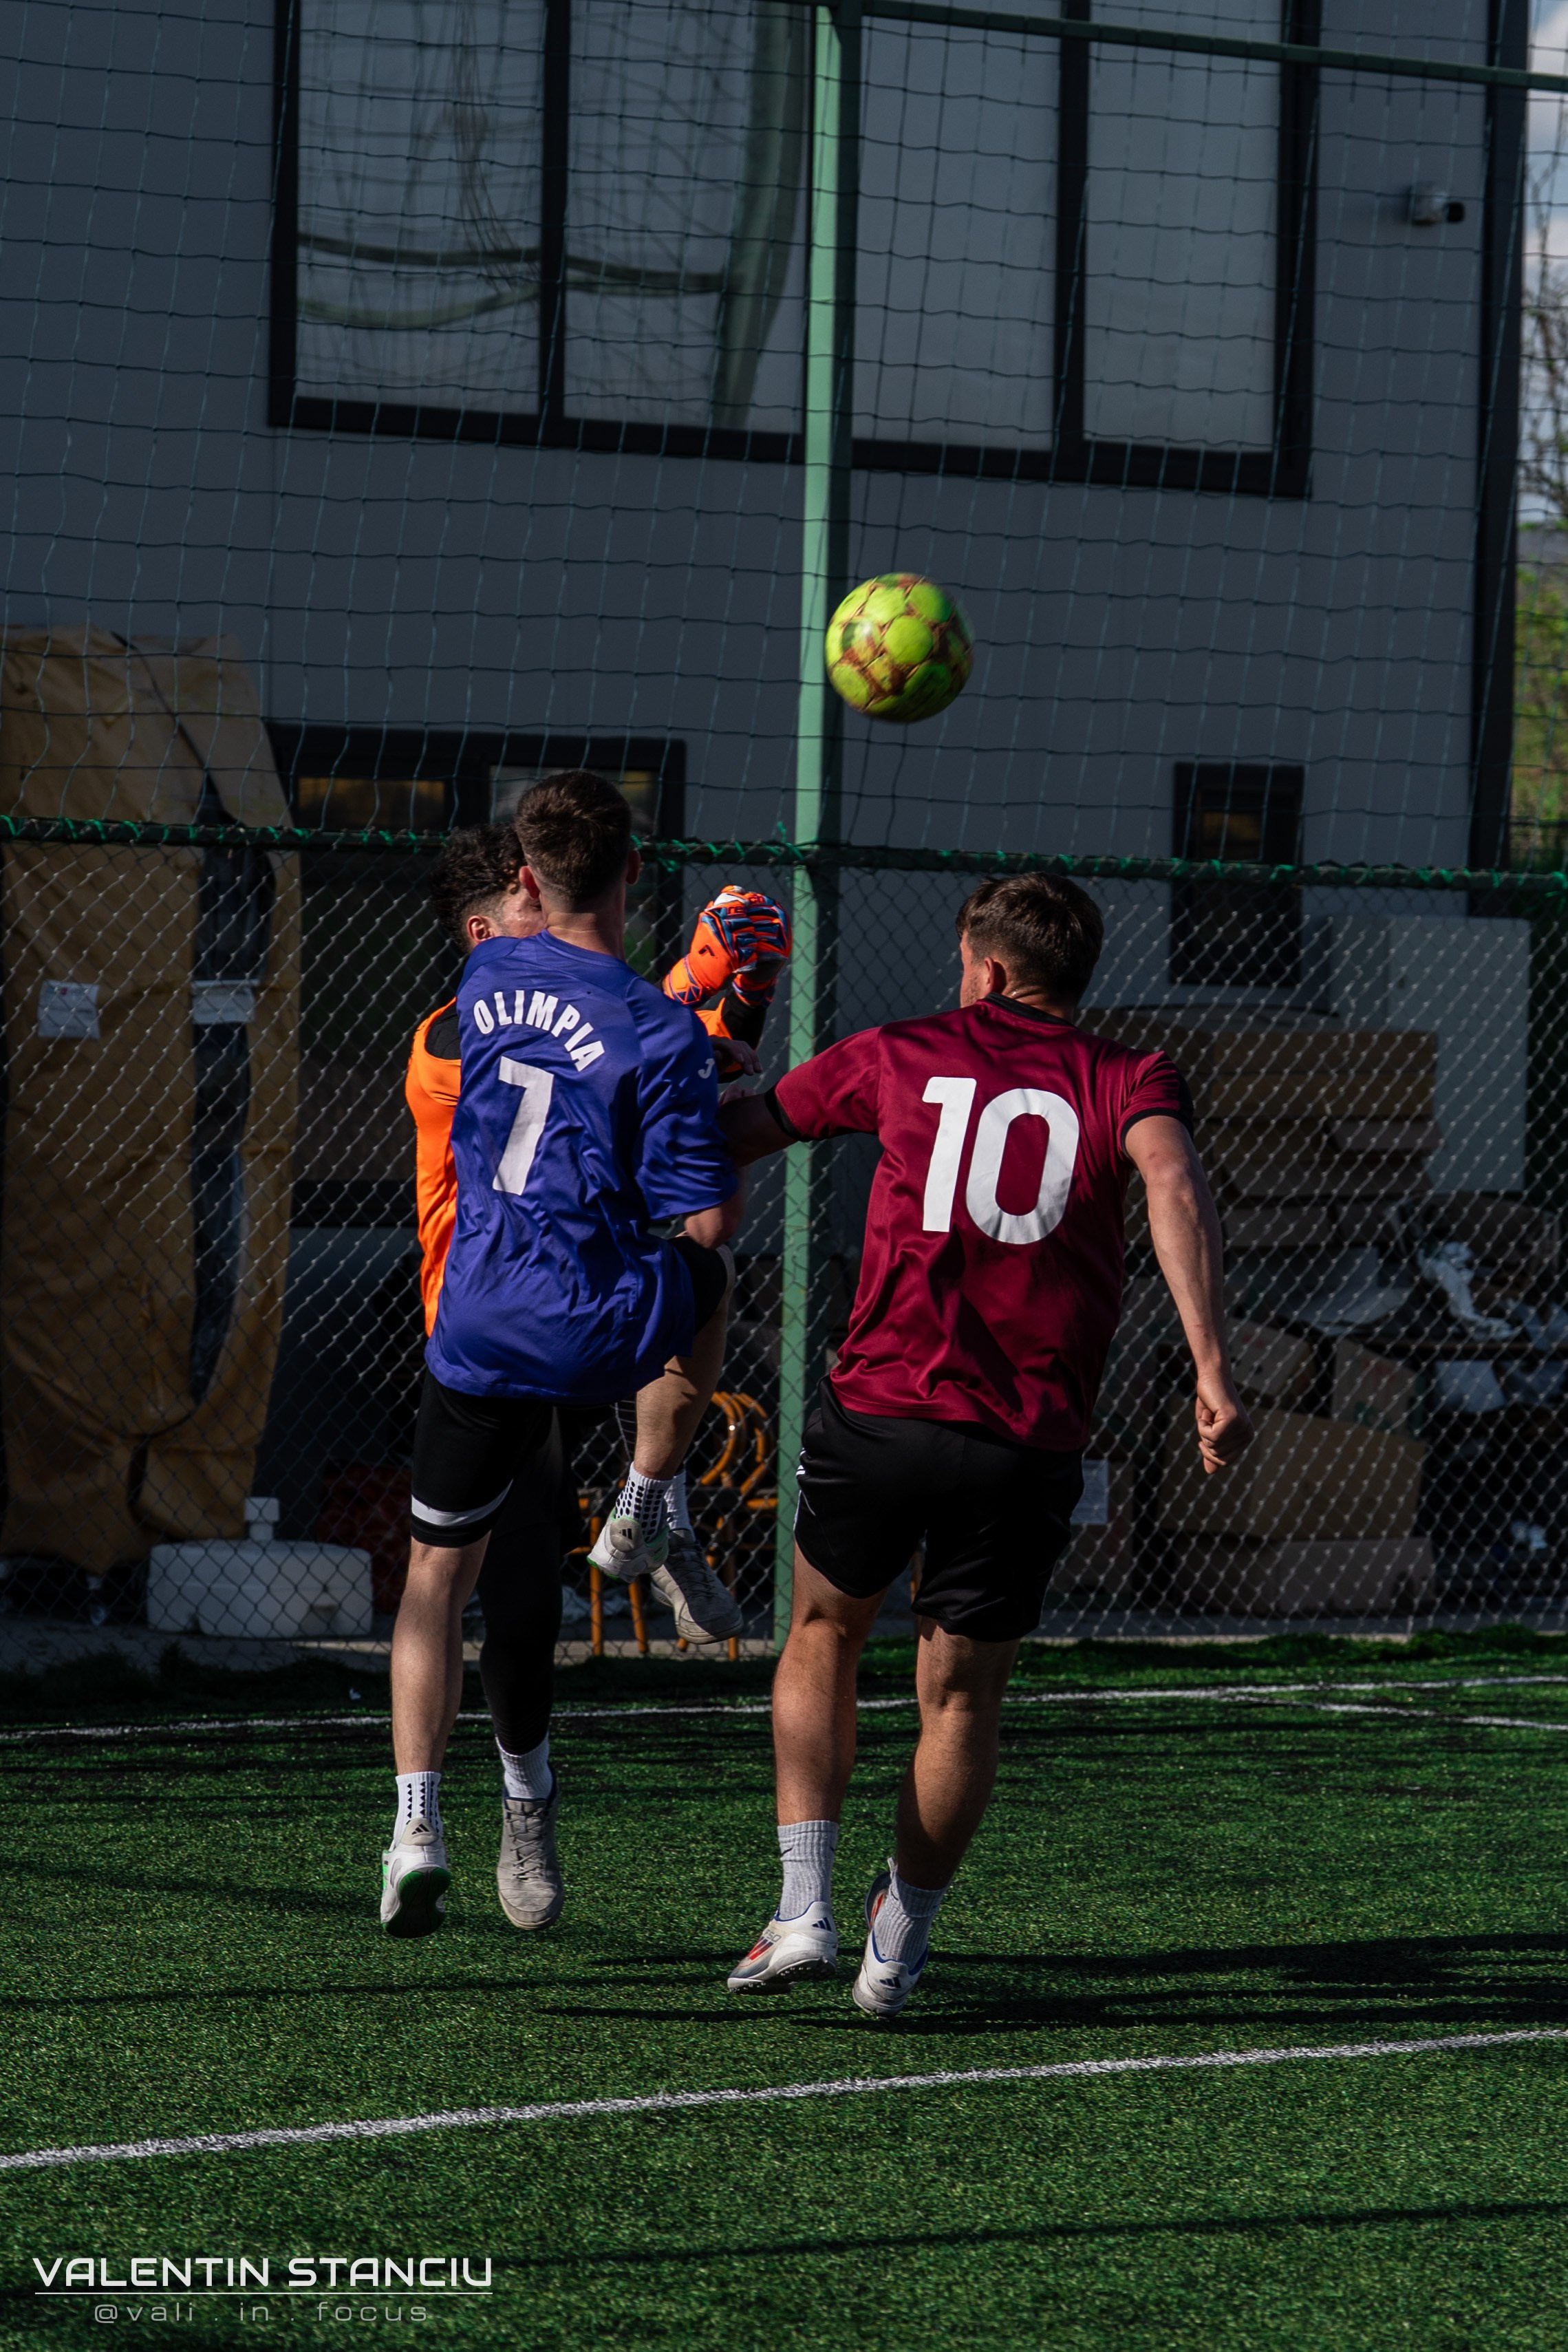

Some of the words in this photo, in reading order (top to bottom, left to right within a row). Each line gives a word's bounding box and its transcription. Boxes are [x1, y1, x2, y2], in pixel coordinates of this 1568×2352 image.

[473, 990, 605, 1072] OLIMPIA
[493, 1056, 555, 1196] 7
[922, 1076, 1080, 1245] 10
